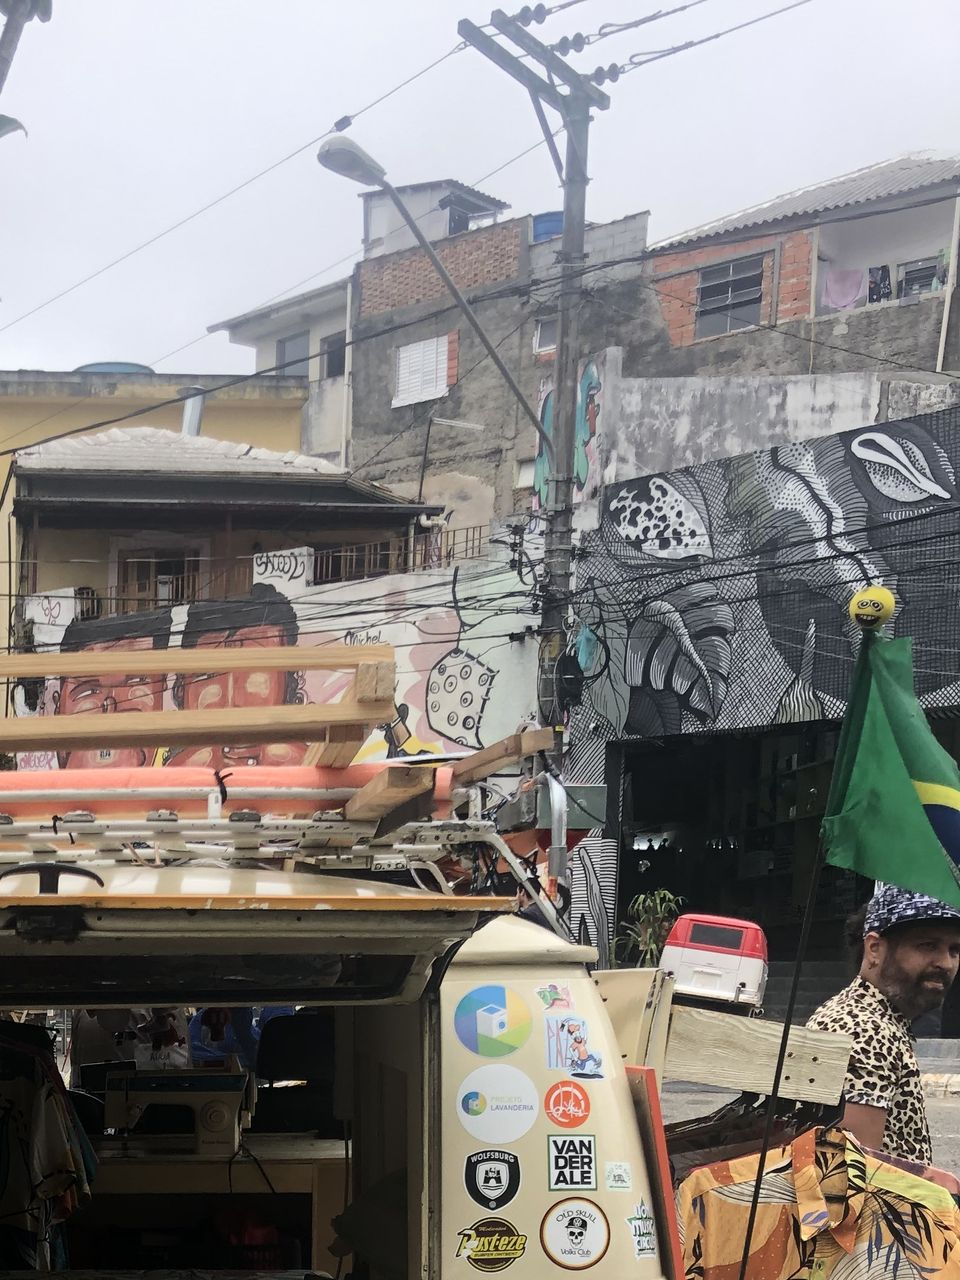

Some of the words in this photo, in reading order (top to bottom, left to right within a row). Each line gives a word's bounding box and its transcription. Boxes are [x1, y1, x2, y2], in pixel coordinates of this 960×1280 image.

[552, 1139, 592, 1155] VAN
[470, 1152, 515, 1163] WOLFSBURG
[554, 1155, 593, 1170] DER
[554, 1171, 593, 1186] ALE
[555, 1210, 574, 1223] OLD
[576, 1209, 597, 1224] SKULL
